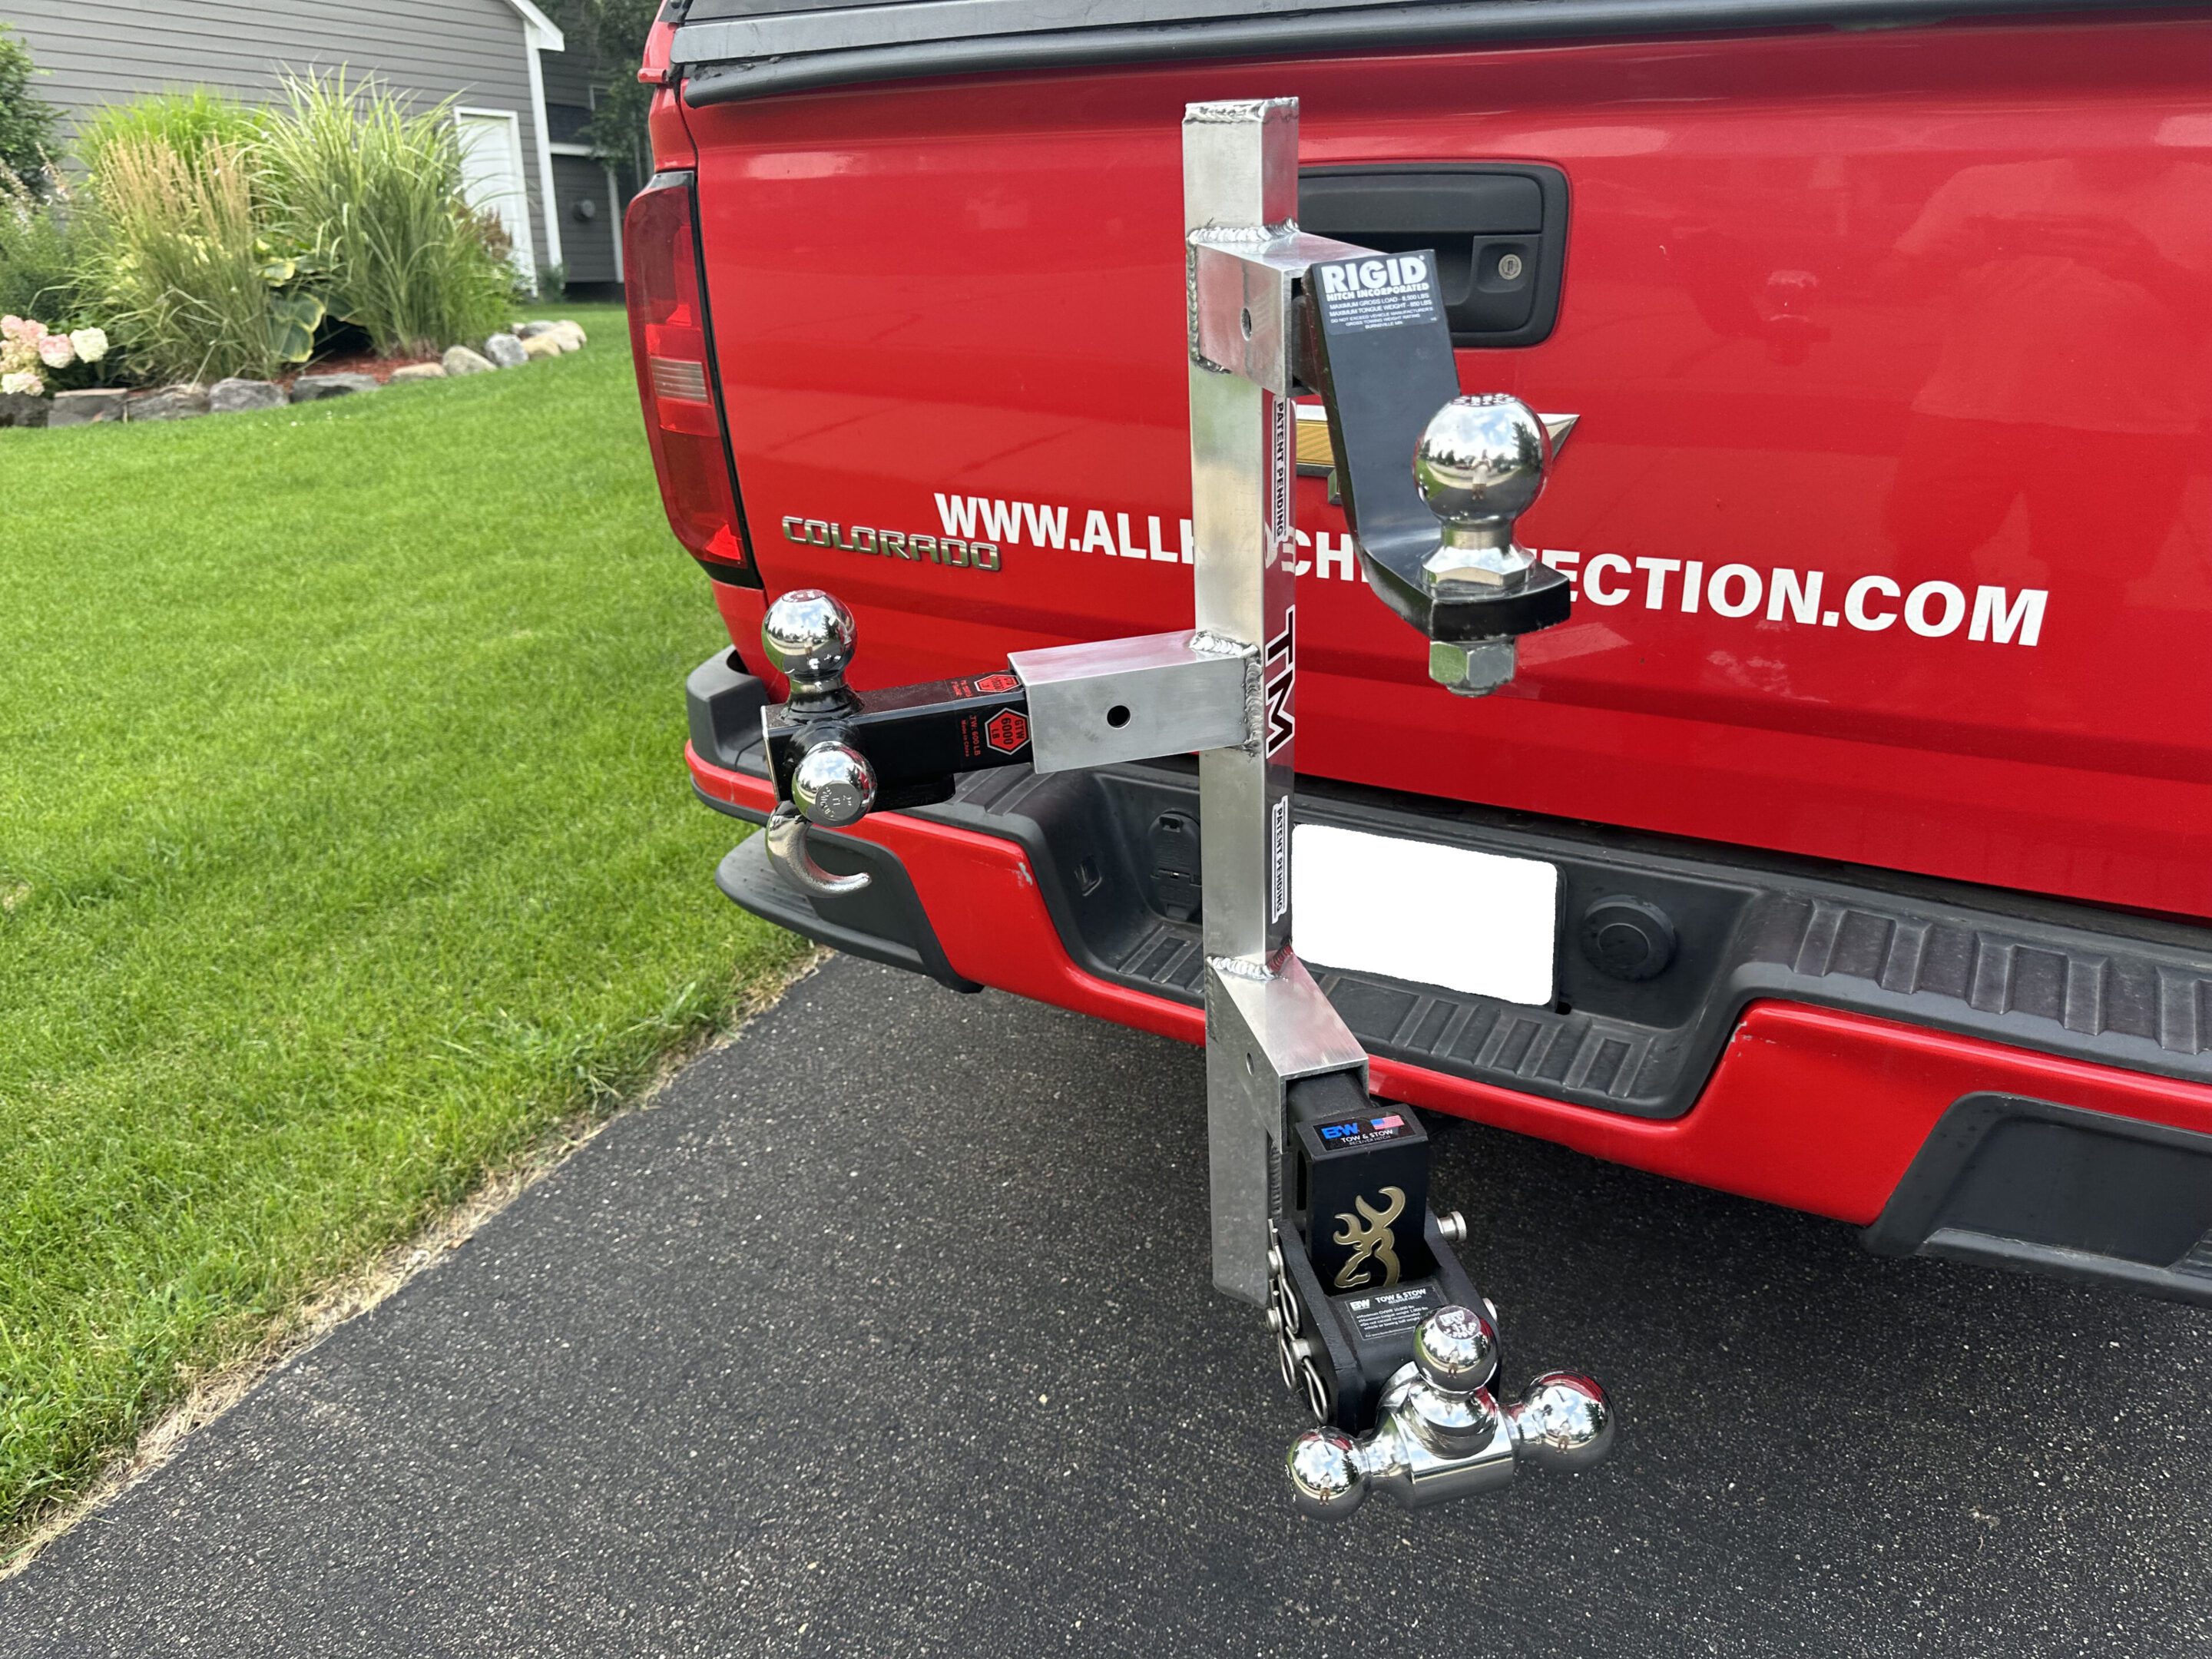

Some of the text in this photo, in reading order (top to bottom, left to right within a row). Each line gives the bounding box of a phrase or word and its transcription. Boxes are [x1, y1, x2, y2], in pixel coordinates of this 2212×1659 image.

[1321, 257, 1427, 293] RIGID
[1326, 283, 1429, 301] HITCH INCORPORATED
[1330, 301, 1359, 310] MAXIMUM
[1359, 298, 1381, 307] GROSS
[1358, 305, 1383, 313] TONGUE
[1382, 303, 1406, 311] WEIGHT
[781, 515, 1002, 571] COLORADO
[992, 729, 1000, 739] LB
[1001, 717, 1014, 745] 6000
[1014, 719, 1025, 739] GTW
[972, 731, 980, 745] 600
[973, 745, 982, 756] LB
[1340, 1134, 1361, 1144] TOW
[1369, 1128, 1394, 1138] STOW
[1375, 1294, 1394, 1303] TOW
[1402, 1288, 1427, 1298] STOW
